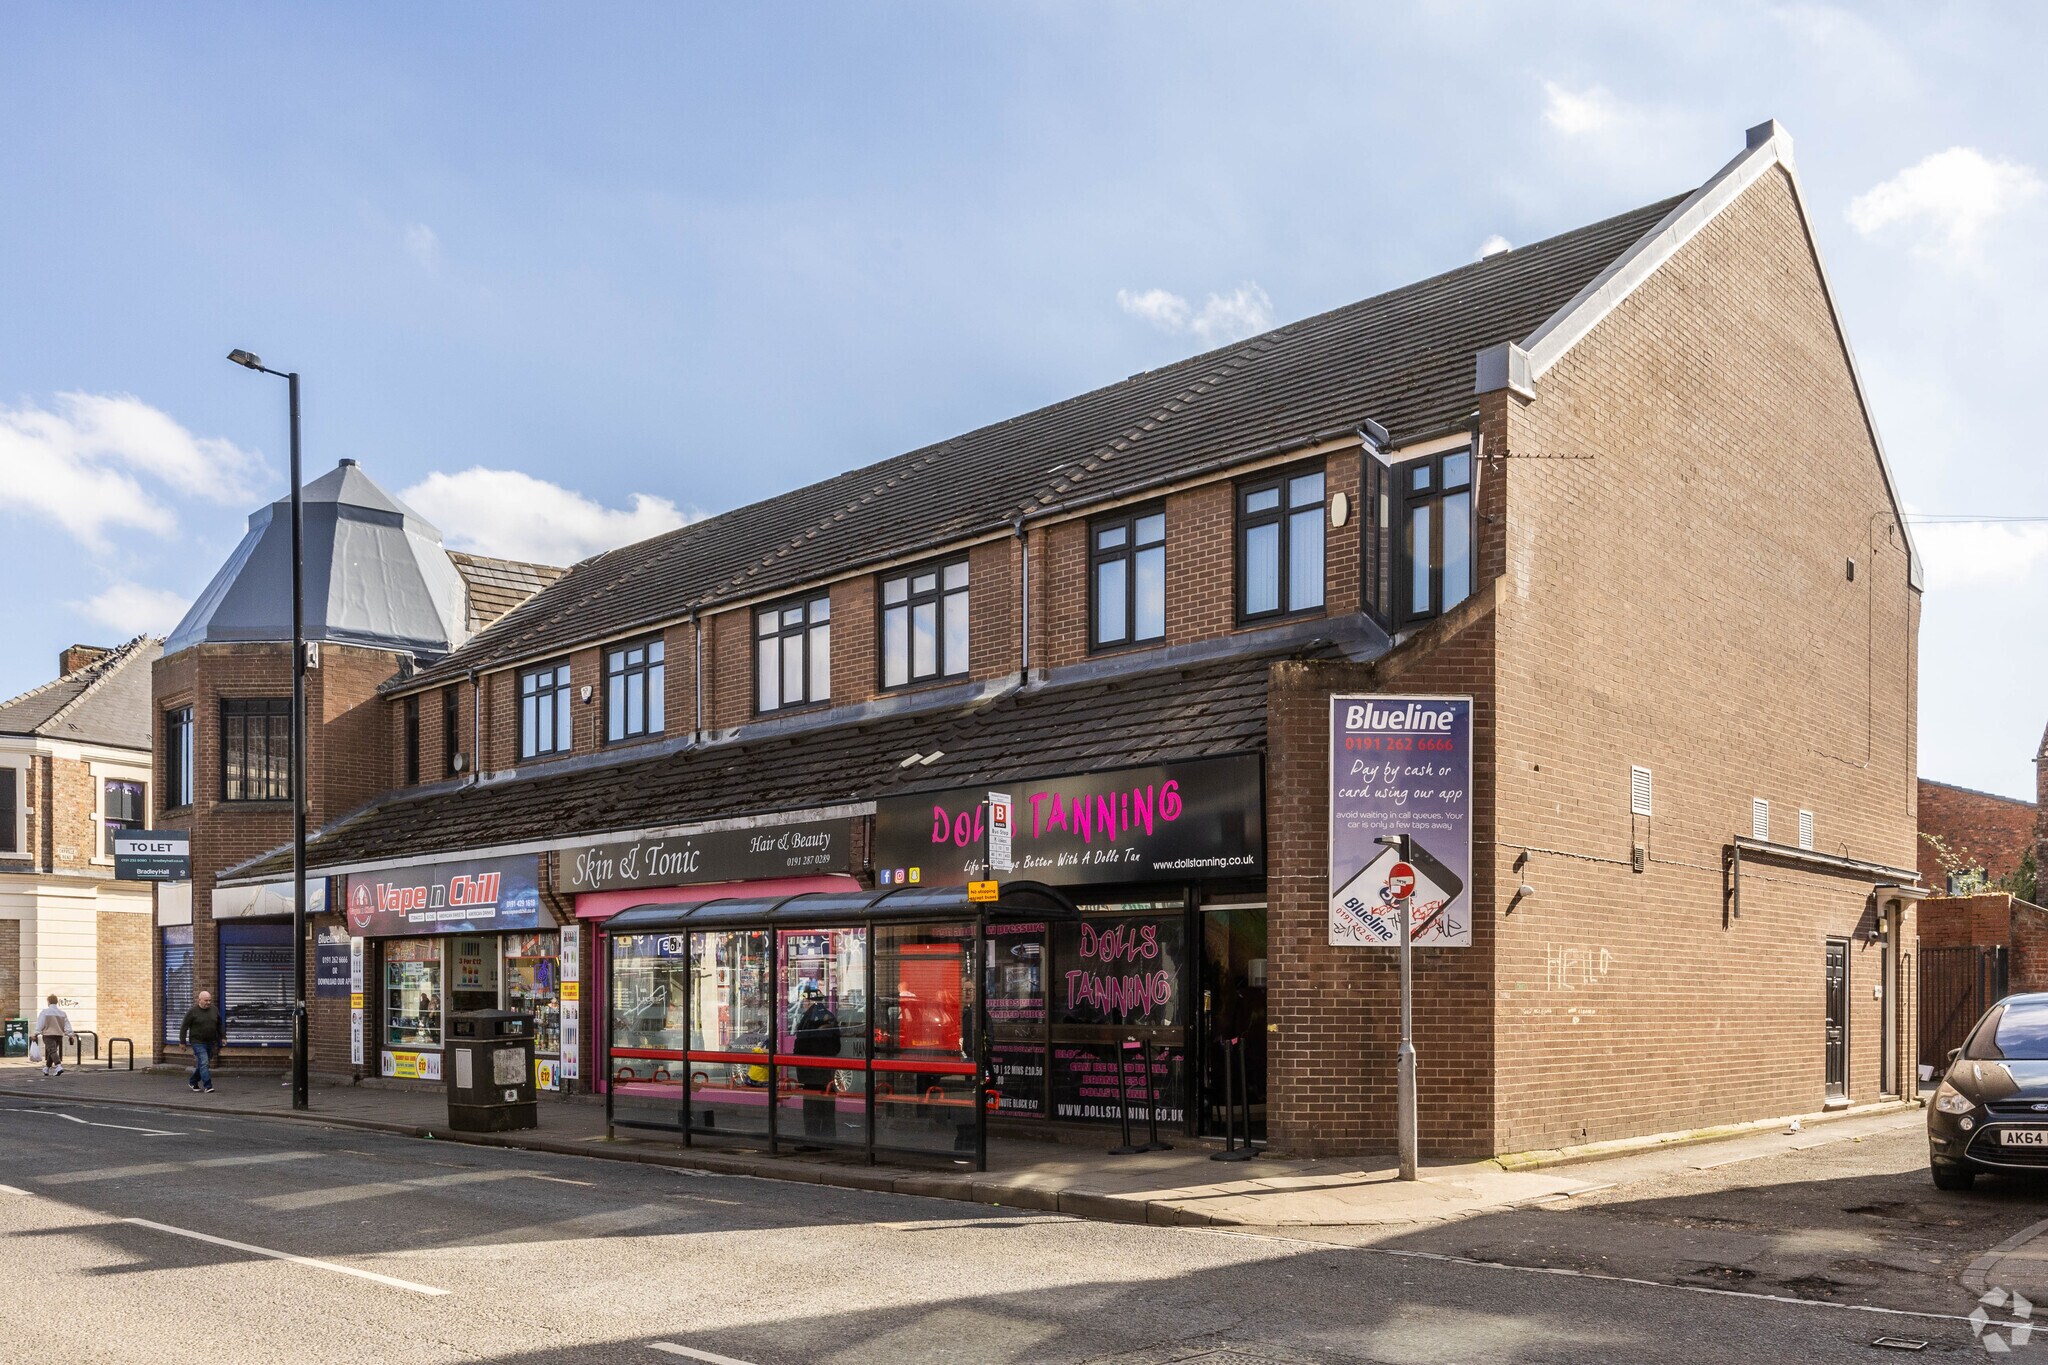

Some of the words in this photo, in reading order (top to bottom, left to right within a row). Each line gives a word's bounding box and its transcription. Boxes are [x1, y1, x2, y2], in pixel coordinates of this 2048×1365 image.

[1345, 702, 1454, 730] Blueline
[1345, 737, 1381, 751] 0191
[1386, 737, 1413, 751] 262
[1417, 739, 1453, 751] 6666
[1350, 759, 1379, 783] Pay
[1384, 761, 1400, 783] by
[1404, 762, 1434, 776] cash
[1438, 766, 1452, 776] or
[1338, 785, 1370, 798] card
[1375, 786, 1409, 806] using
[1413, 789, 1434, 798] our
[1439, 789, 1463, 803] app
[1336, 811, 1359, 819] avoid
[1359, 811, 1388, 821] waiting
[1390, 811, 1397, 819] in
[1398, 811, 1412, 819] call
[1412, 813, 1444, 821] queues.
[1445, 812, 1464, 820] Your
[1361, 821, 1369, 829] is
[1370, 821, 1388, 831] only
[1396, 820, 1411, 829] few
[1412, 822, 1430, 831] taps
[1431, 823, 1453, 831] away
[129, 842, 148, 852] TO
[150, 843, 173, 852] LET
[749, 835, 776, 853] Hair
[777, 831, 790, 851] &
[791, 832, 831, 851] Beauty
[572, 848, 613, 888] Skin
[620, 843, 640, 880] &
[645, 841, 700, 876] Tonic
[786, 857, 801, 867] 0191
[802, 855, 814, 865] 287
[814, 854, 831, 864] 0289
[1023, 855, 1053, 869] Better
[1057, 852, 1078, 867] With
[1081, 850, 1090, 860] A
[1094, 850, 1120, 864] Dolls
[1124, 847, 1141, 862] Tan
[1153, 855, 1254, 870] www.dollstanning.co.uk
[377, 883, 428, 917] Vape
[429, 884, 446, 909] n
[448, 872, 501, 907] Chill
[997, 922, 1045, 935] pressure
[1335, 907, 1353, 925] 0191
[1352, 922, 1367, 936] 262
[1344, 897, 1394, 942] Blueline
[1080, 923, 1158, 962] DOLLS
[1003, 1065, 1011, 1075] 12
[1011, 1065, 1024, 1076] MINS
[2006, 1132, 2043, 1144] AK64
